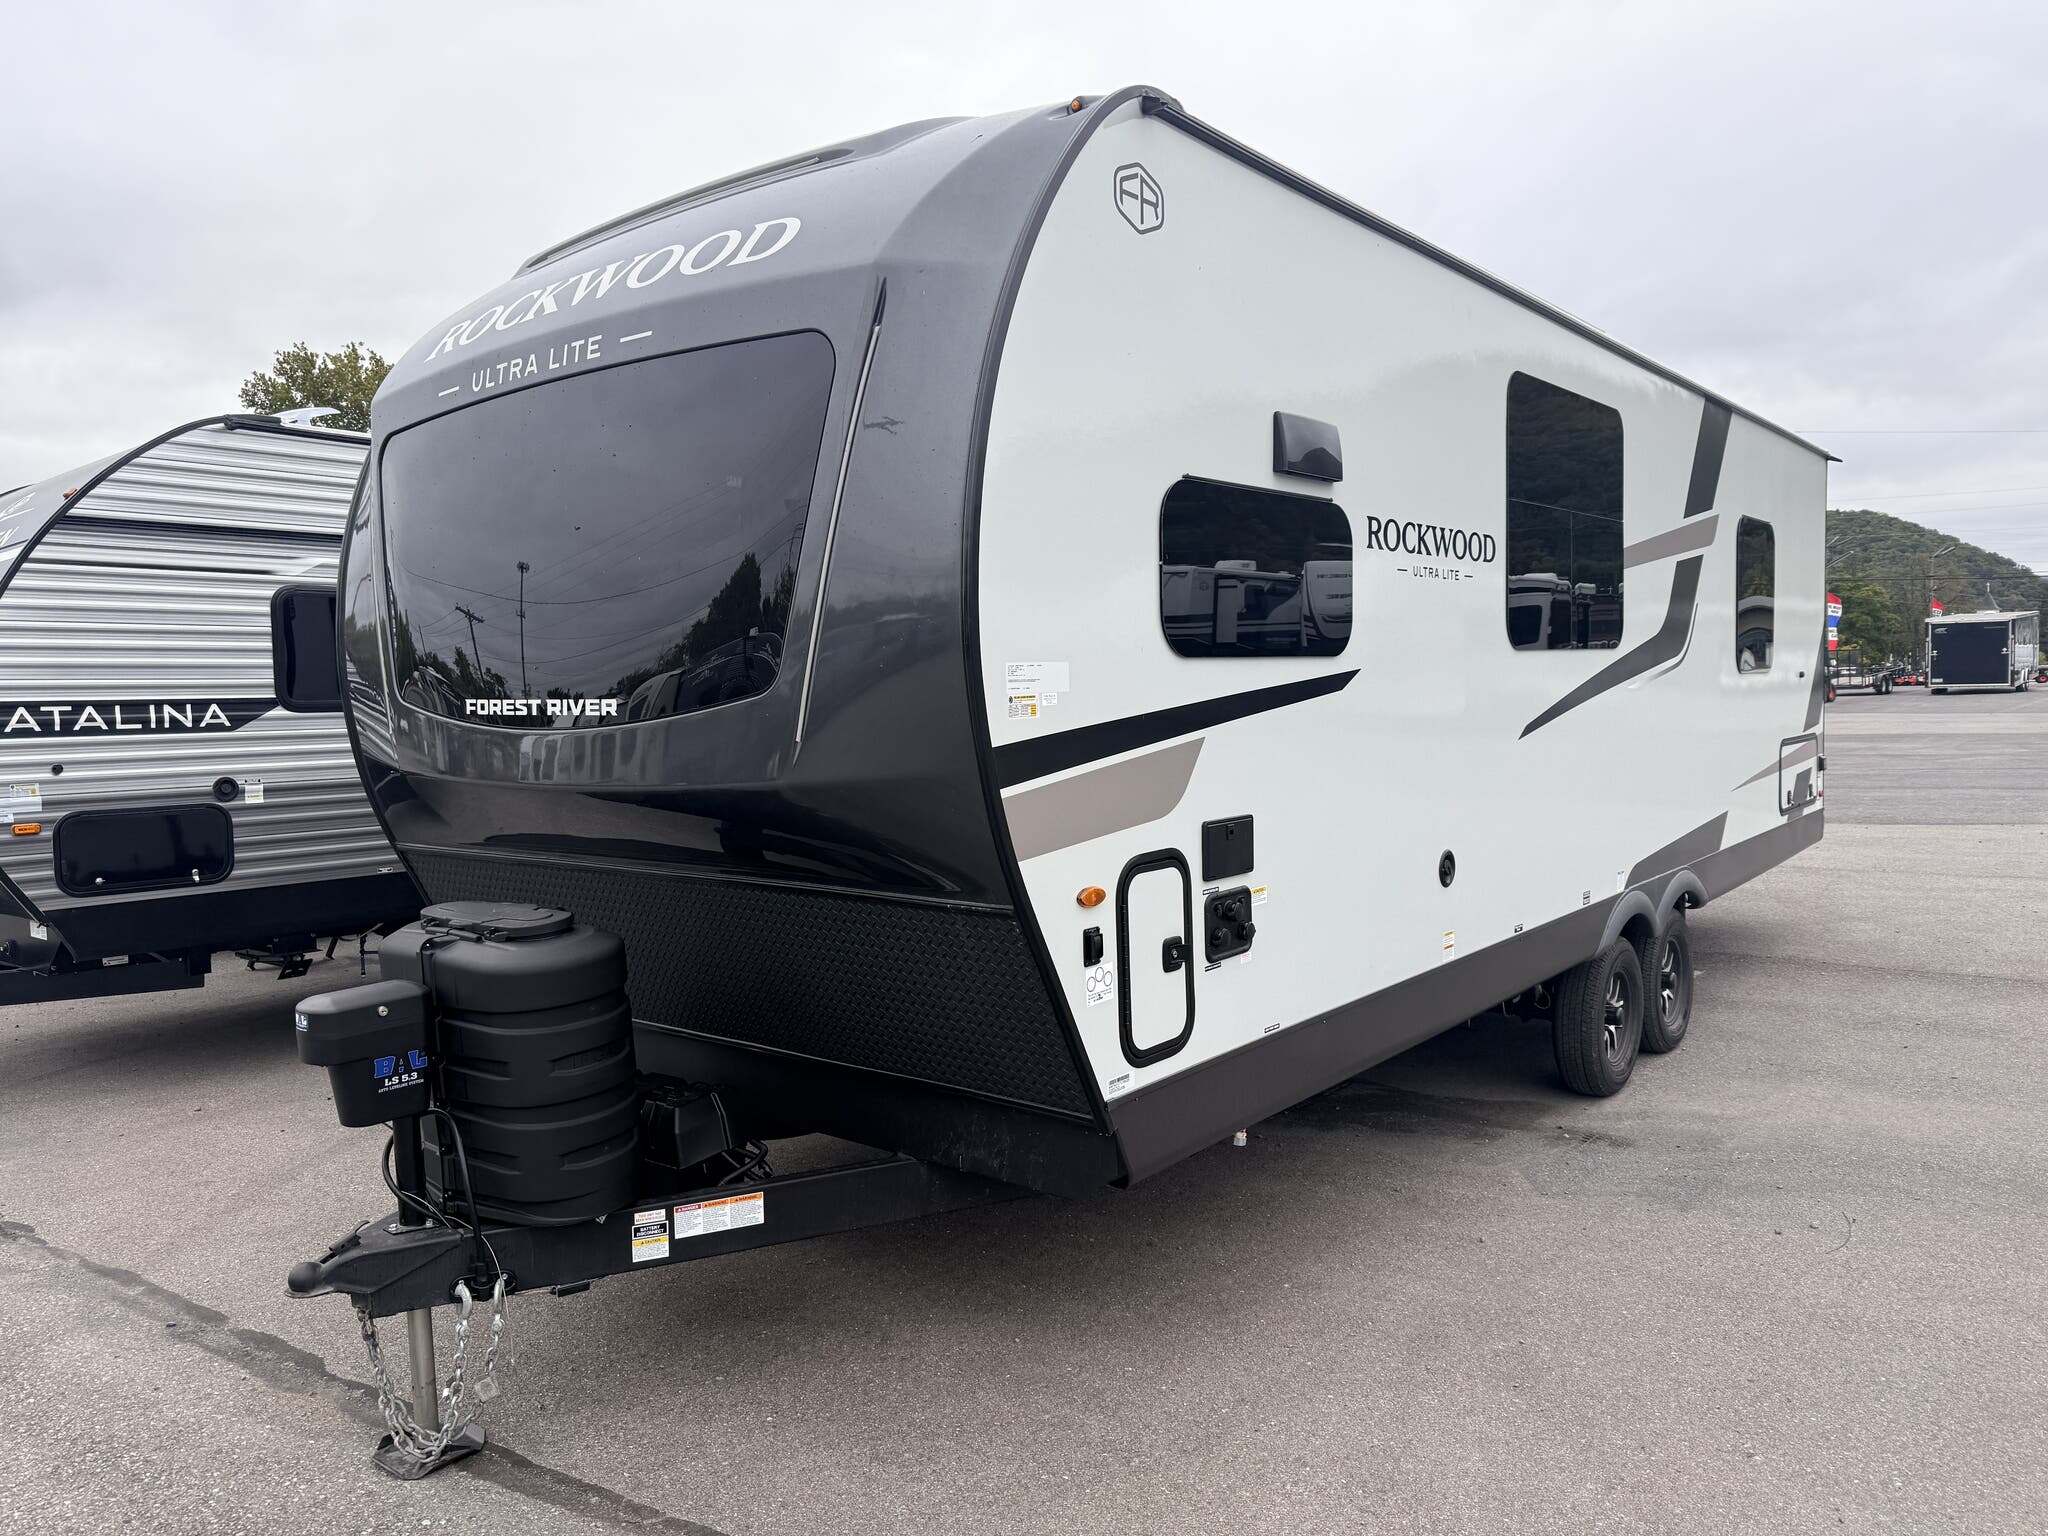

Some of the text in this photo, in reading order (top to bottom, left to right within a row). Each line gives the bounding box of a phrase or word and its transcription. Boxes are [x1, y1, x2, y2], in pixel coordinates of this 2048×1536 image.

[424, 217, 801, 364] ROCKWOOD
[472, 335, 602, 393] ULTRA LITE
[1366, 515, 1497, 563] ROCKWOOD
[1412, 565, 1460, 581] ULTRA LITE
[465, 699, 618, 716] FOREST RIVER
[384, 1071, 418, 1087] LS 5.3
